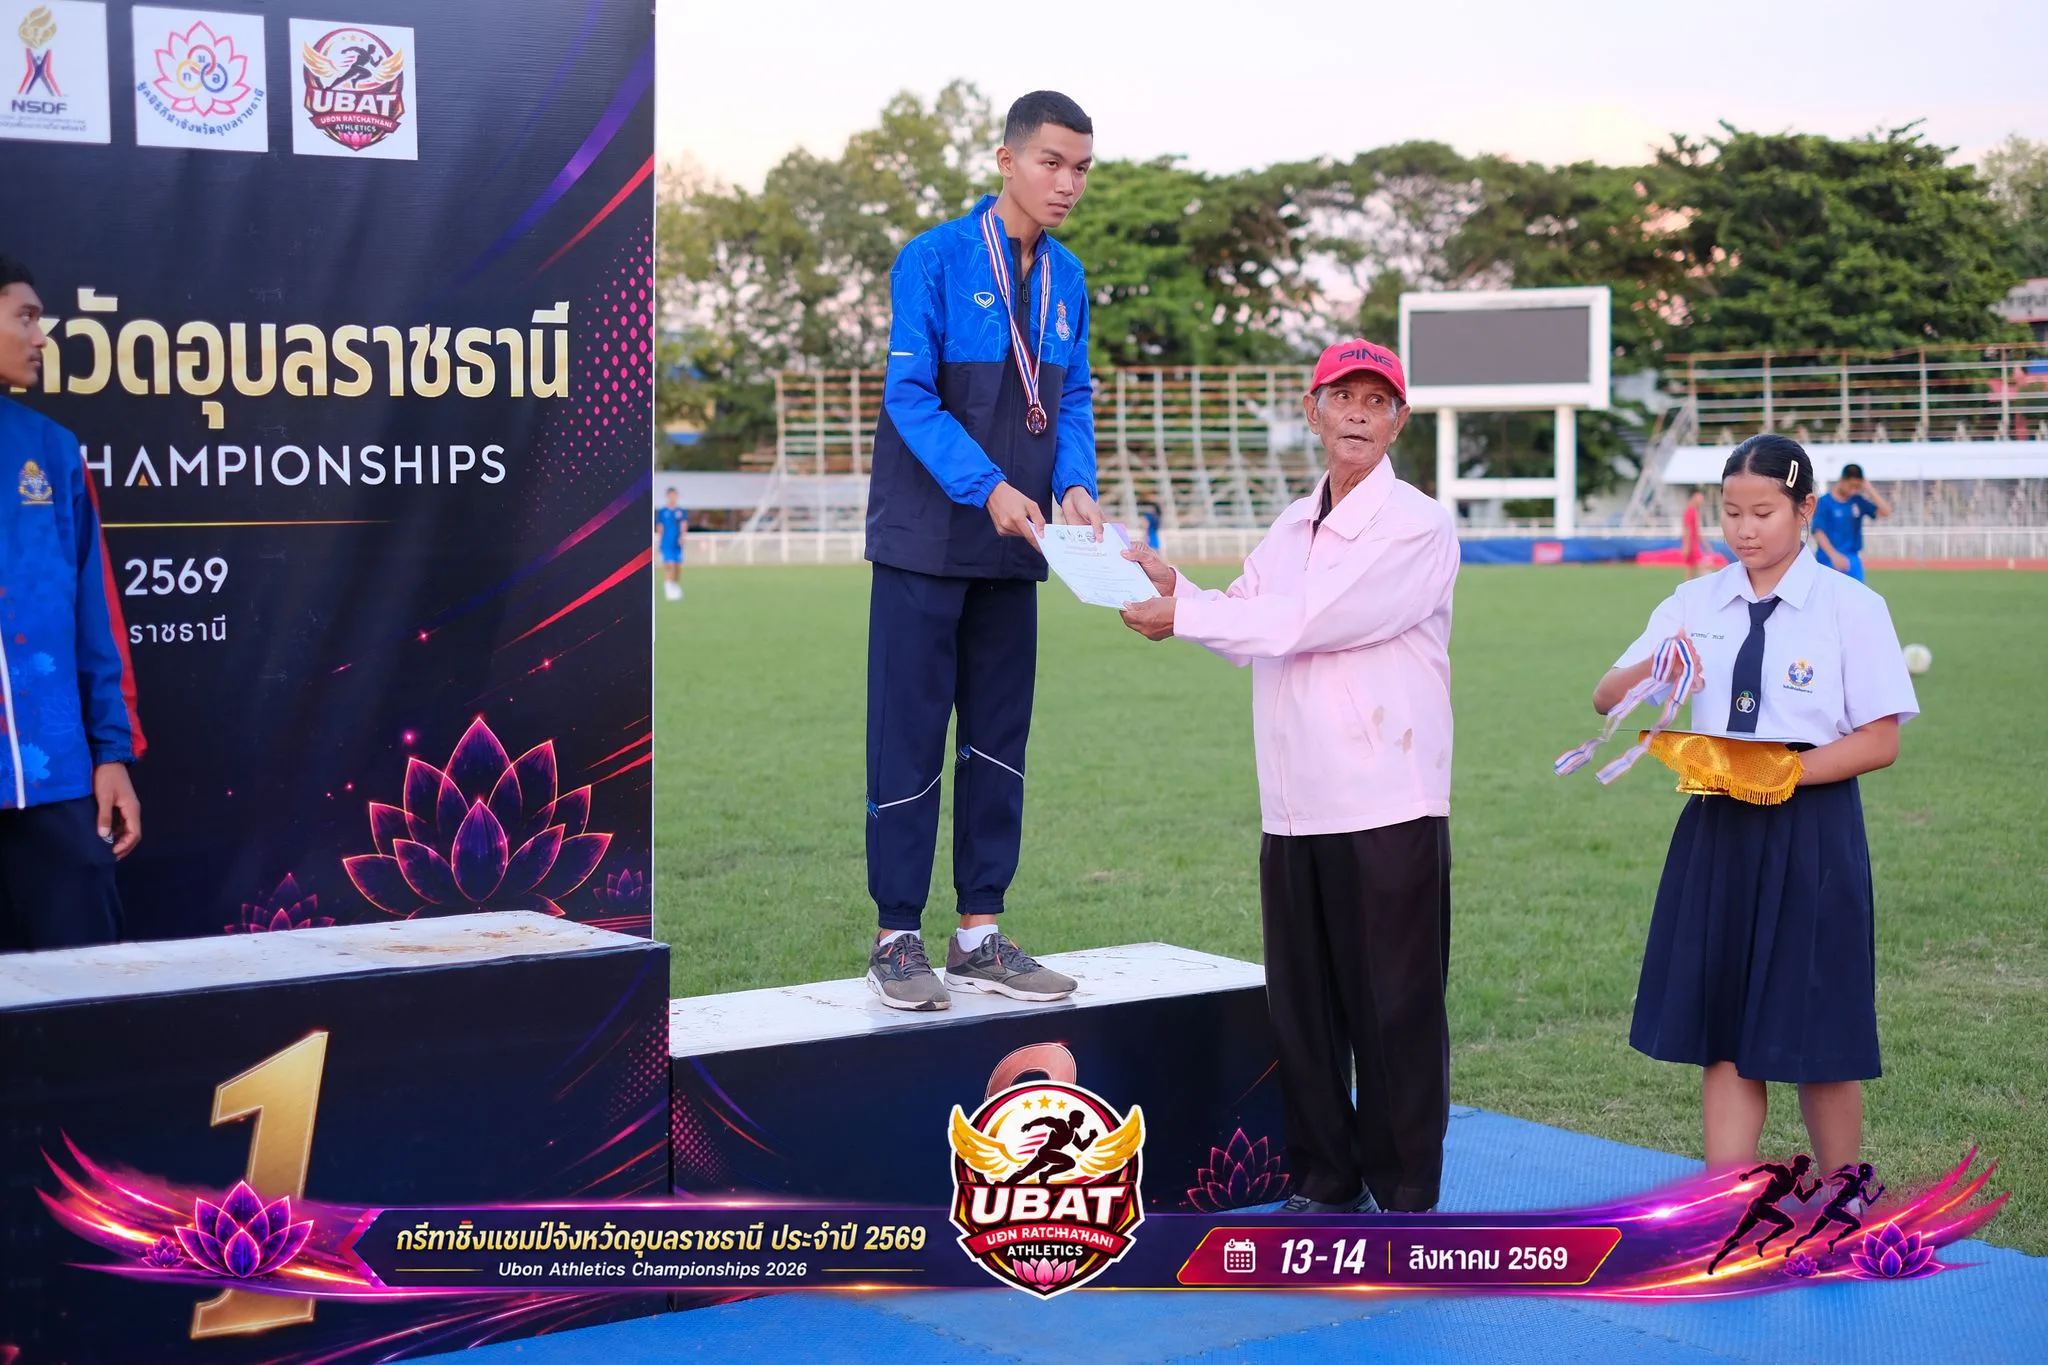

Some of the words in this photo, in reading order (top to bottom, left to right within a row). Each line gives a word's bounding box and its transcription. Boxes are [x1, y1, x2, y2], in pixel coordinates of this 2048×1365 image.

[12, 99, 68, 115] NSDF
[312, 89, 397, 117] UBAT
[320, 115, 342, 124] UBON
[342, 115, 393, 128] RATCHATHANI
[335, 124, 377, 133] ATHLETICS
[1340, 349, 1393, 368] PING
[124, 557, 229, 596] 2569
